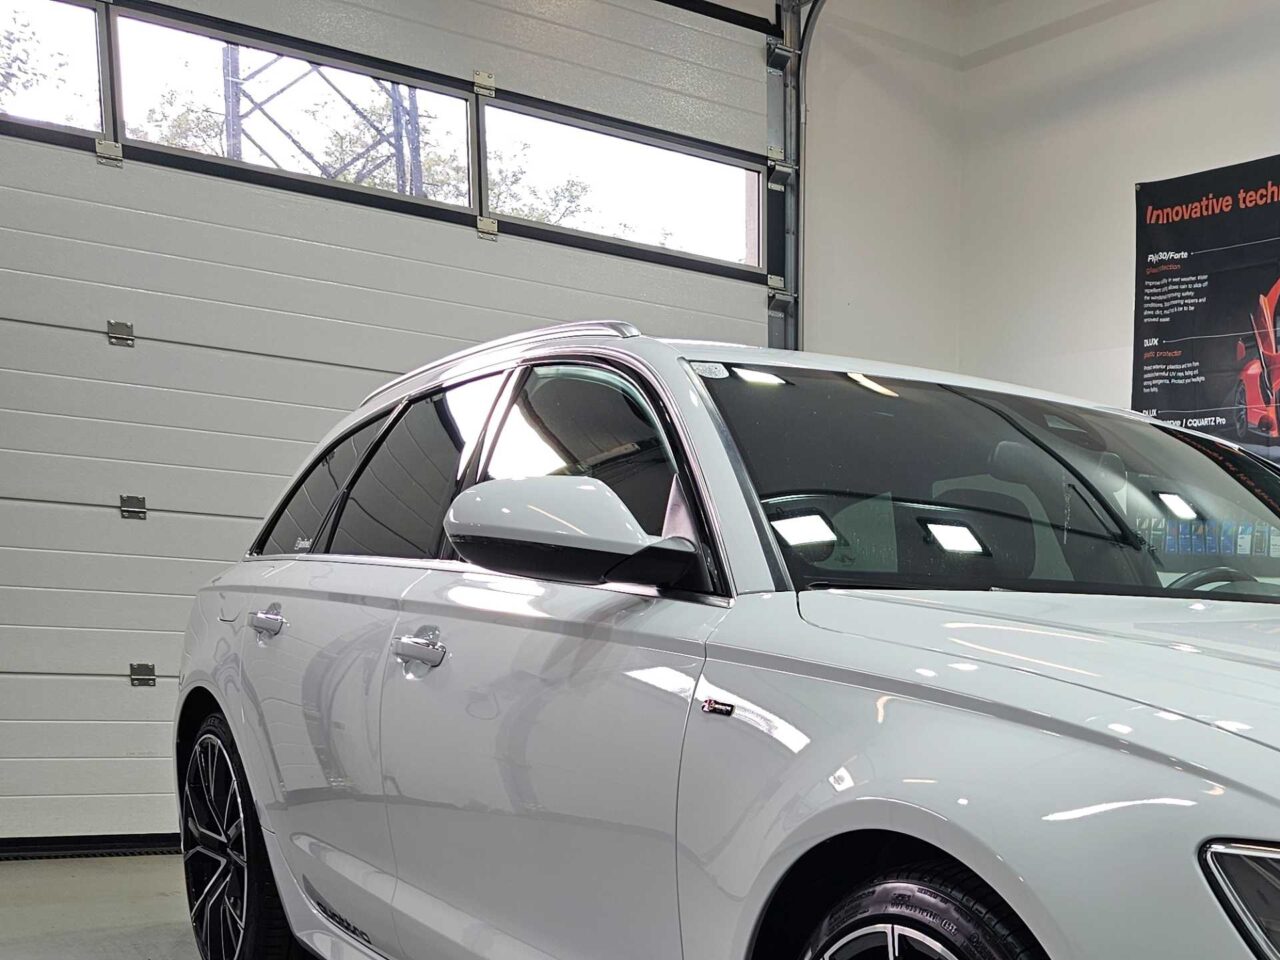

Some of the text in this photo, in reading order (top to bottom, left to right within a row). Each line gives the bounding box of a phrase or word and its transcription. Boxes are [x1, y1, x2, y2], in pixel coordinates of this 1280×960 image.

[1146, 193, 1232, 225] Innovative
[1187, 417, 1215, 427] CQUARTZ
[1216, 416, 1226, 425] Pro
